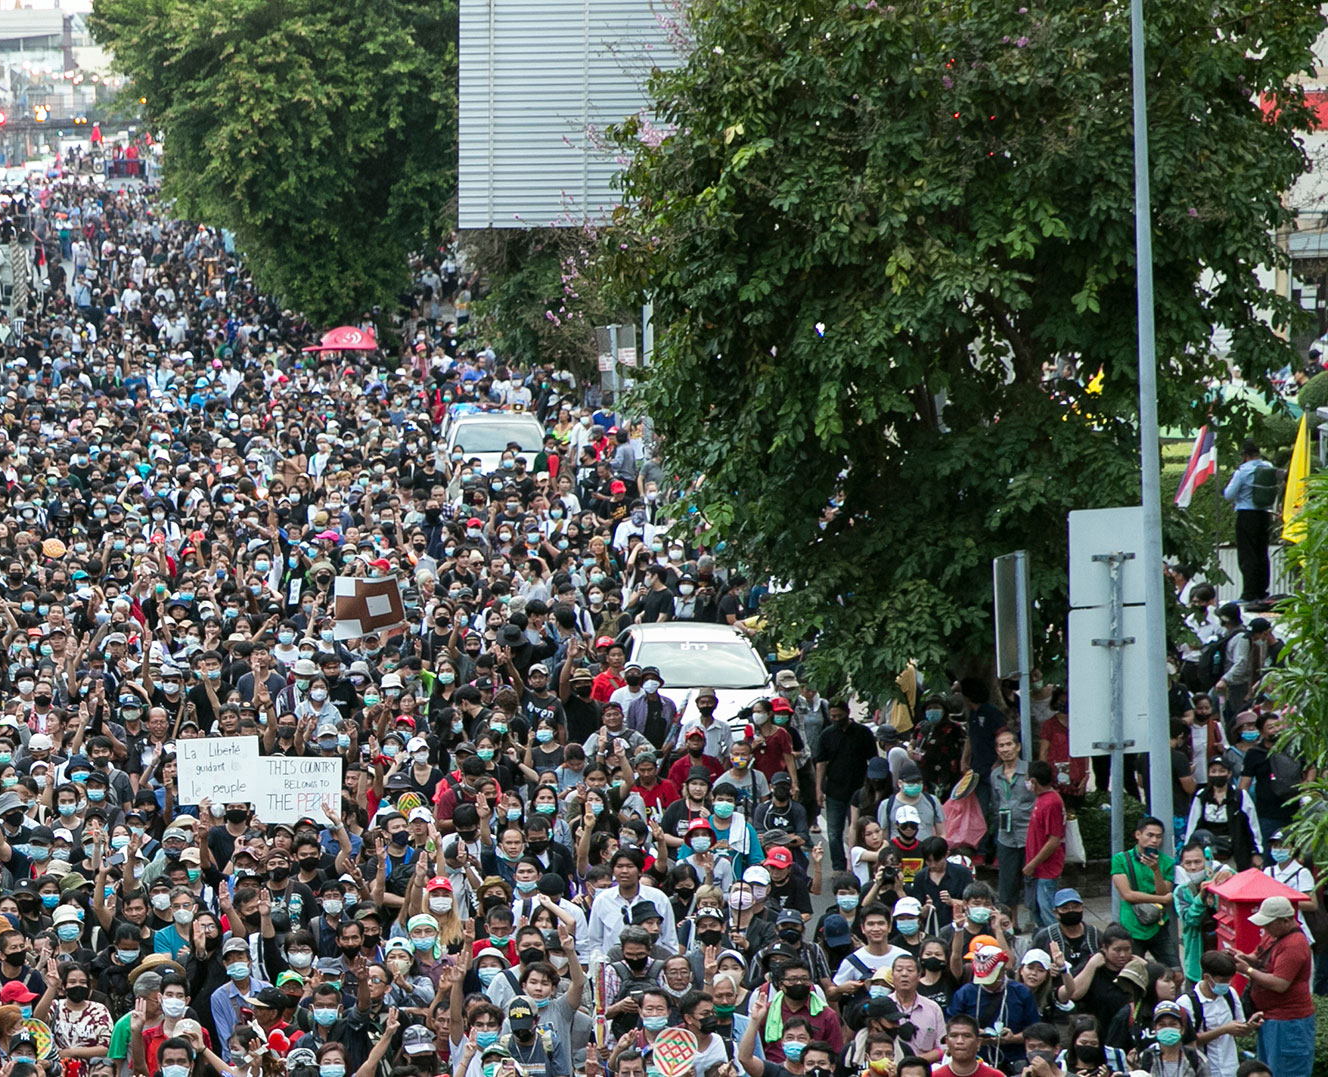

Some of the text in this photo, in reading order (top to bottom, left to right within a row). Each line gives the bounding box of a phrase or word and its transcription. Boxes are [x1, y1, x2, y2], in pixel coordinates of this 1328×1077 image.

[184, 742, 241, 760] La Liberté
[266, 760, 337, 776] THIS COUNTRY
[191, 779, 247, 798] le peuple
[284, 779, 330, 790] BELONGS TO
[266, 793, 294, 811] THE
